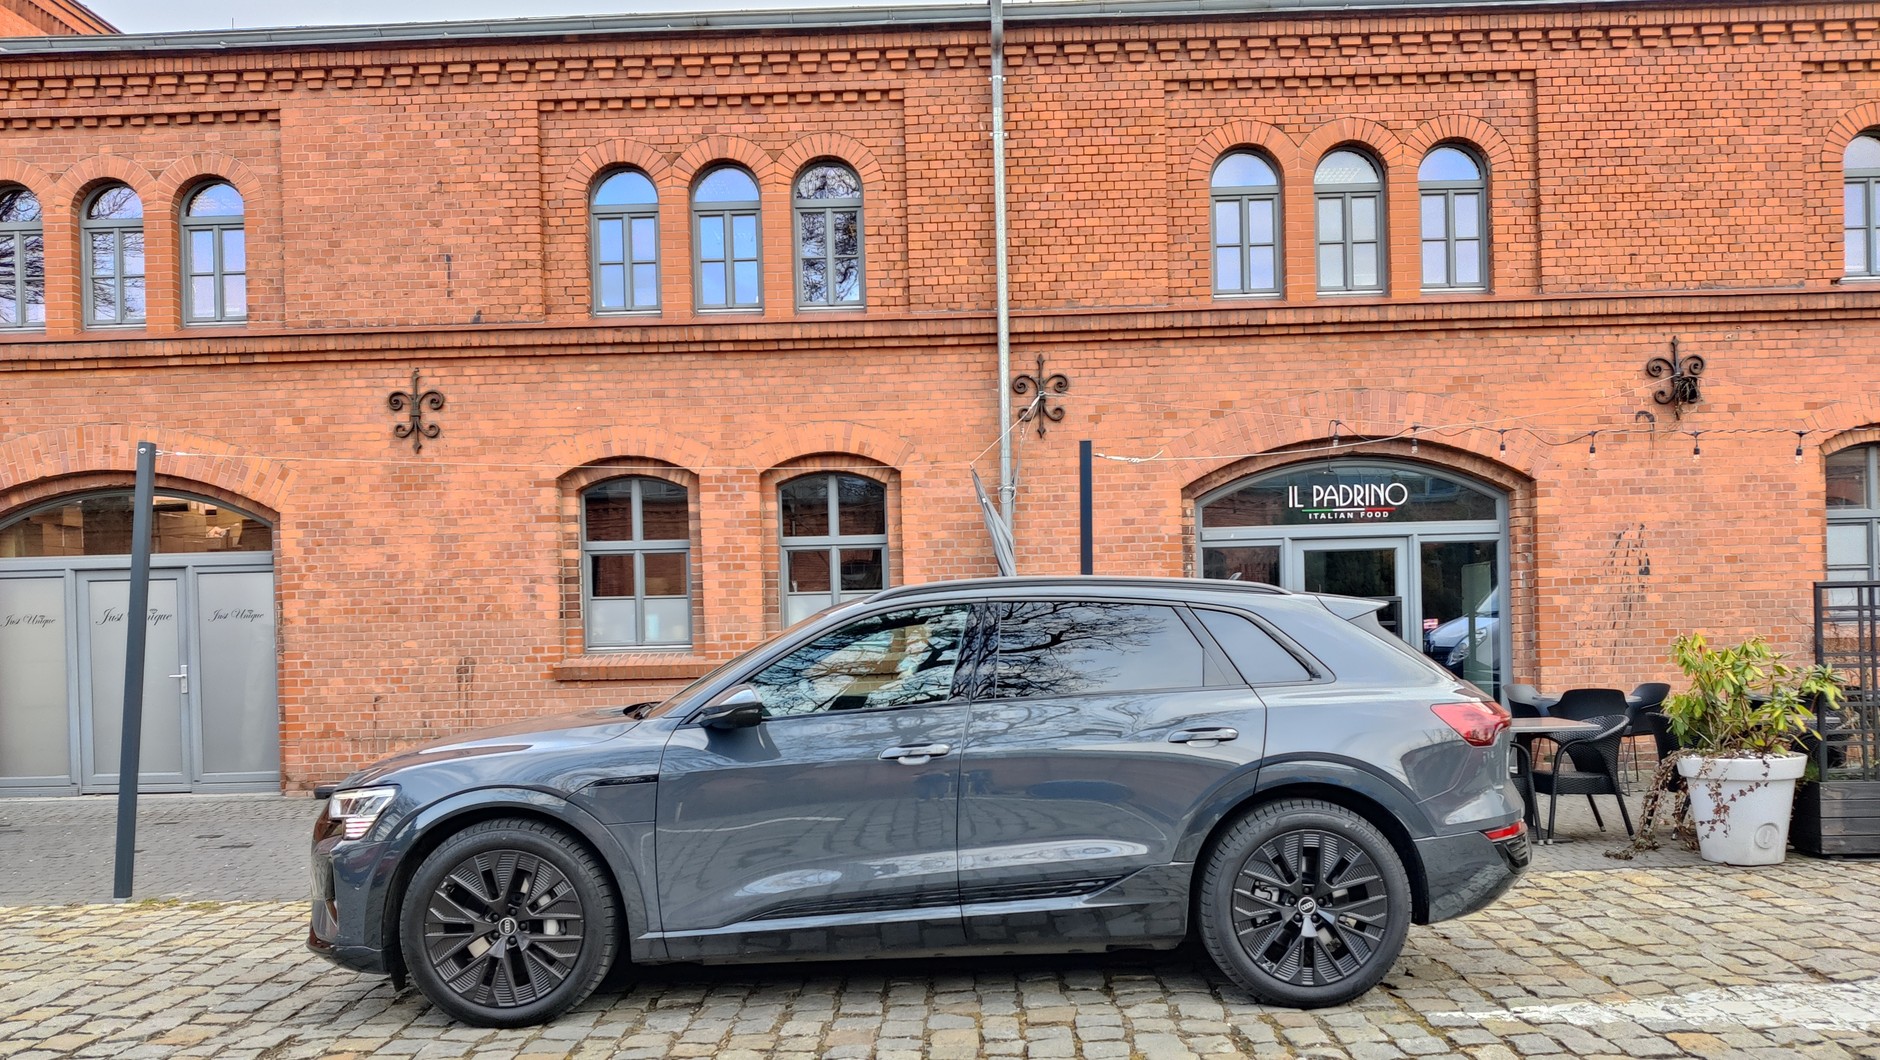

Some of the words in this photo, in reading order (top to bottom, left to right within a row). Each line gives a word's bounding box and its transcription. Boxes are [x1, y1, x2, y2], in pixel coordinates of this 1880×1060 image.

[1288, 485, 1304, 508] IL
[1312, 482, 1408, 507] PADRINO
[1308, 512, 1354, 520] ITALIAN
[0, 614, 21, 628] Just
[22, 614, 56, 628] Unique
[95, 606, 124, 626] Just
[207, 609, 229, 623] Just
[230, 608, 264, 623] Unique
